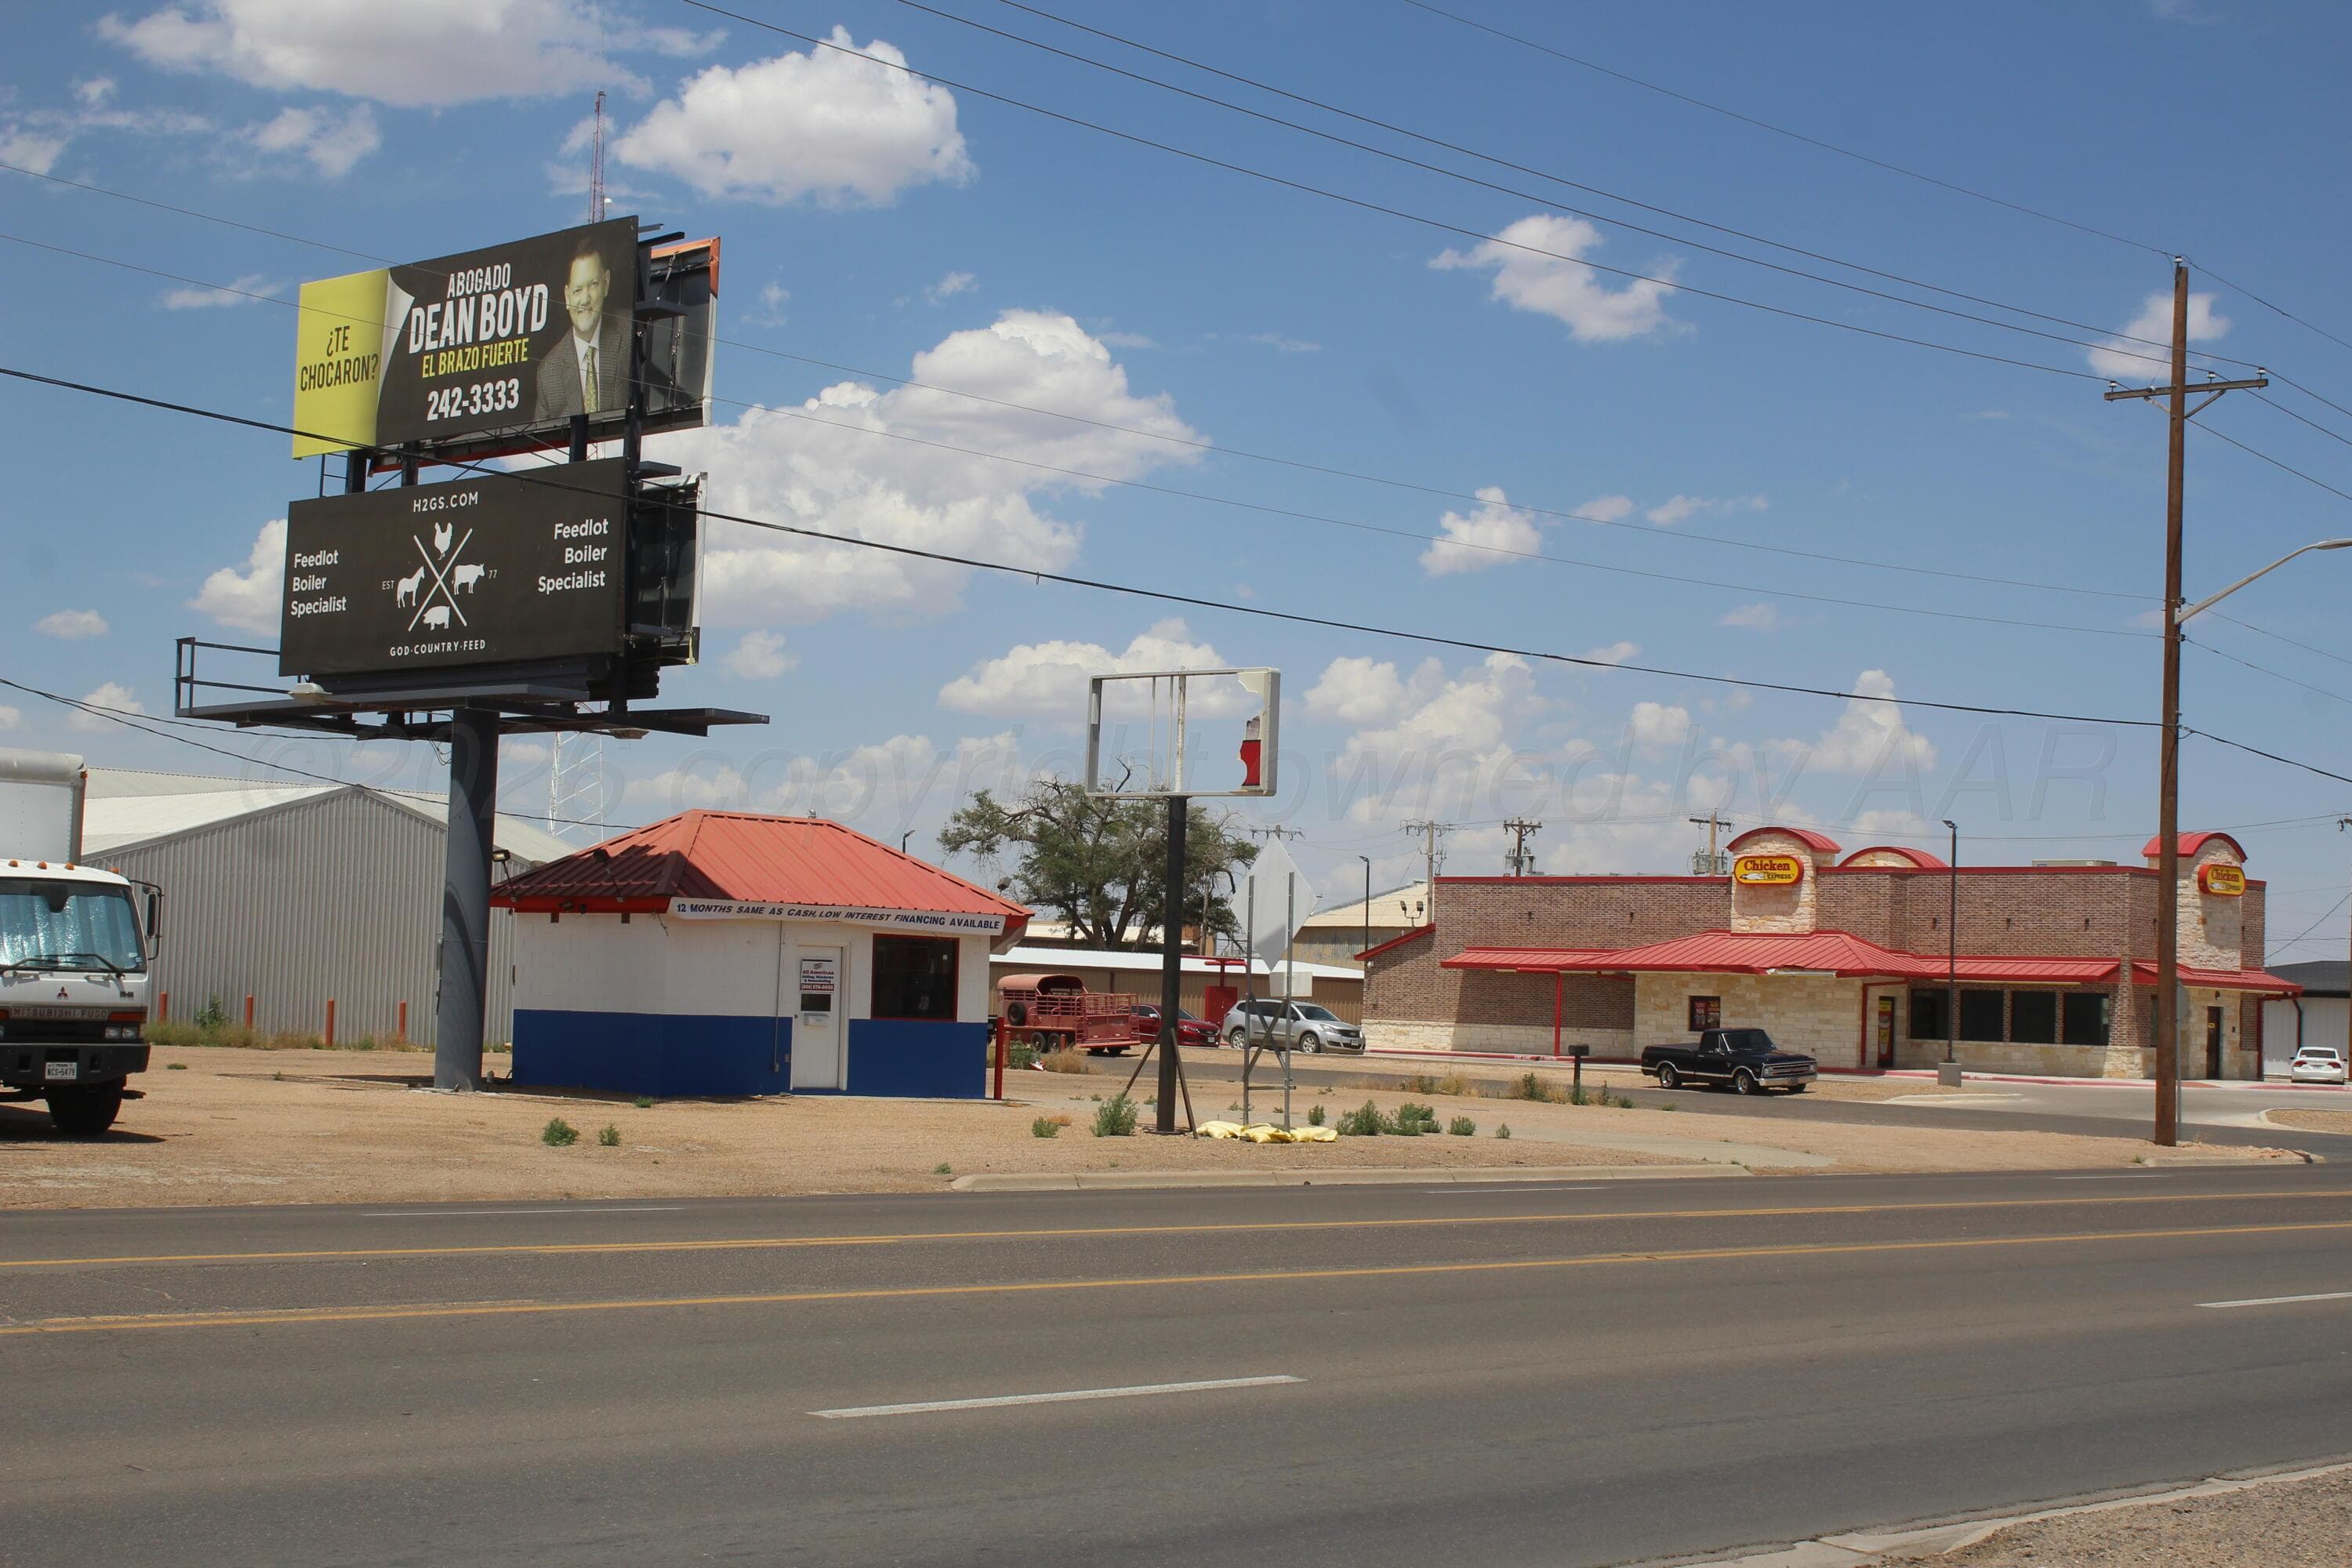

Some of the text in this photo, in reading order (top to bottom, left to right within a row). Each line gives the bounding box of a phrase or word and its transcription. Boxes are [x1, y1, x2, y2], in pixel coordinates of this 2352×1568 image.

[447, 263, 511, 299] ABOGADO
[408, 283, 549, 354] DEAN BOYD
[326, 325, 350, 358] ¿TE
[422, 338, 529, 379] EL BRAZO FUERTE
[300, 353, 379, 391] CHOCARON?
[427, 378, 520, 421] 242-3333
[413, 491, 478, 513] H2GS.COM
[554, 518, 609, 540] Feedlot
[294, 550, 339, 568] Feedlot
[564, 544, 608, 564] Boiler
[292, 574, 327, 592] Boiler
[382, 580, 395, 590] EST
[488, 569, 498, 579] 77
[538, 570, 606, 595] Specialist
[291, 596, 347, 618] Specialist
[1744, 859, 1791, 871] Chicken
[677, 904, 687, 913] 12
[690, 903, 733, 913] MONTHS
[736, 906, 765, 915] SAME
[768, 907, 784, 916] AS
[818, 909, 842, 918] LOW
[844, 911, 892, 921] INTEREST
[894, 913, 946, 925] FINANCING
[949, 917, 1000, 930] AVAILABLE
[12, 1008, 76, 1018] MITSUBISHI
